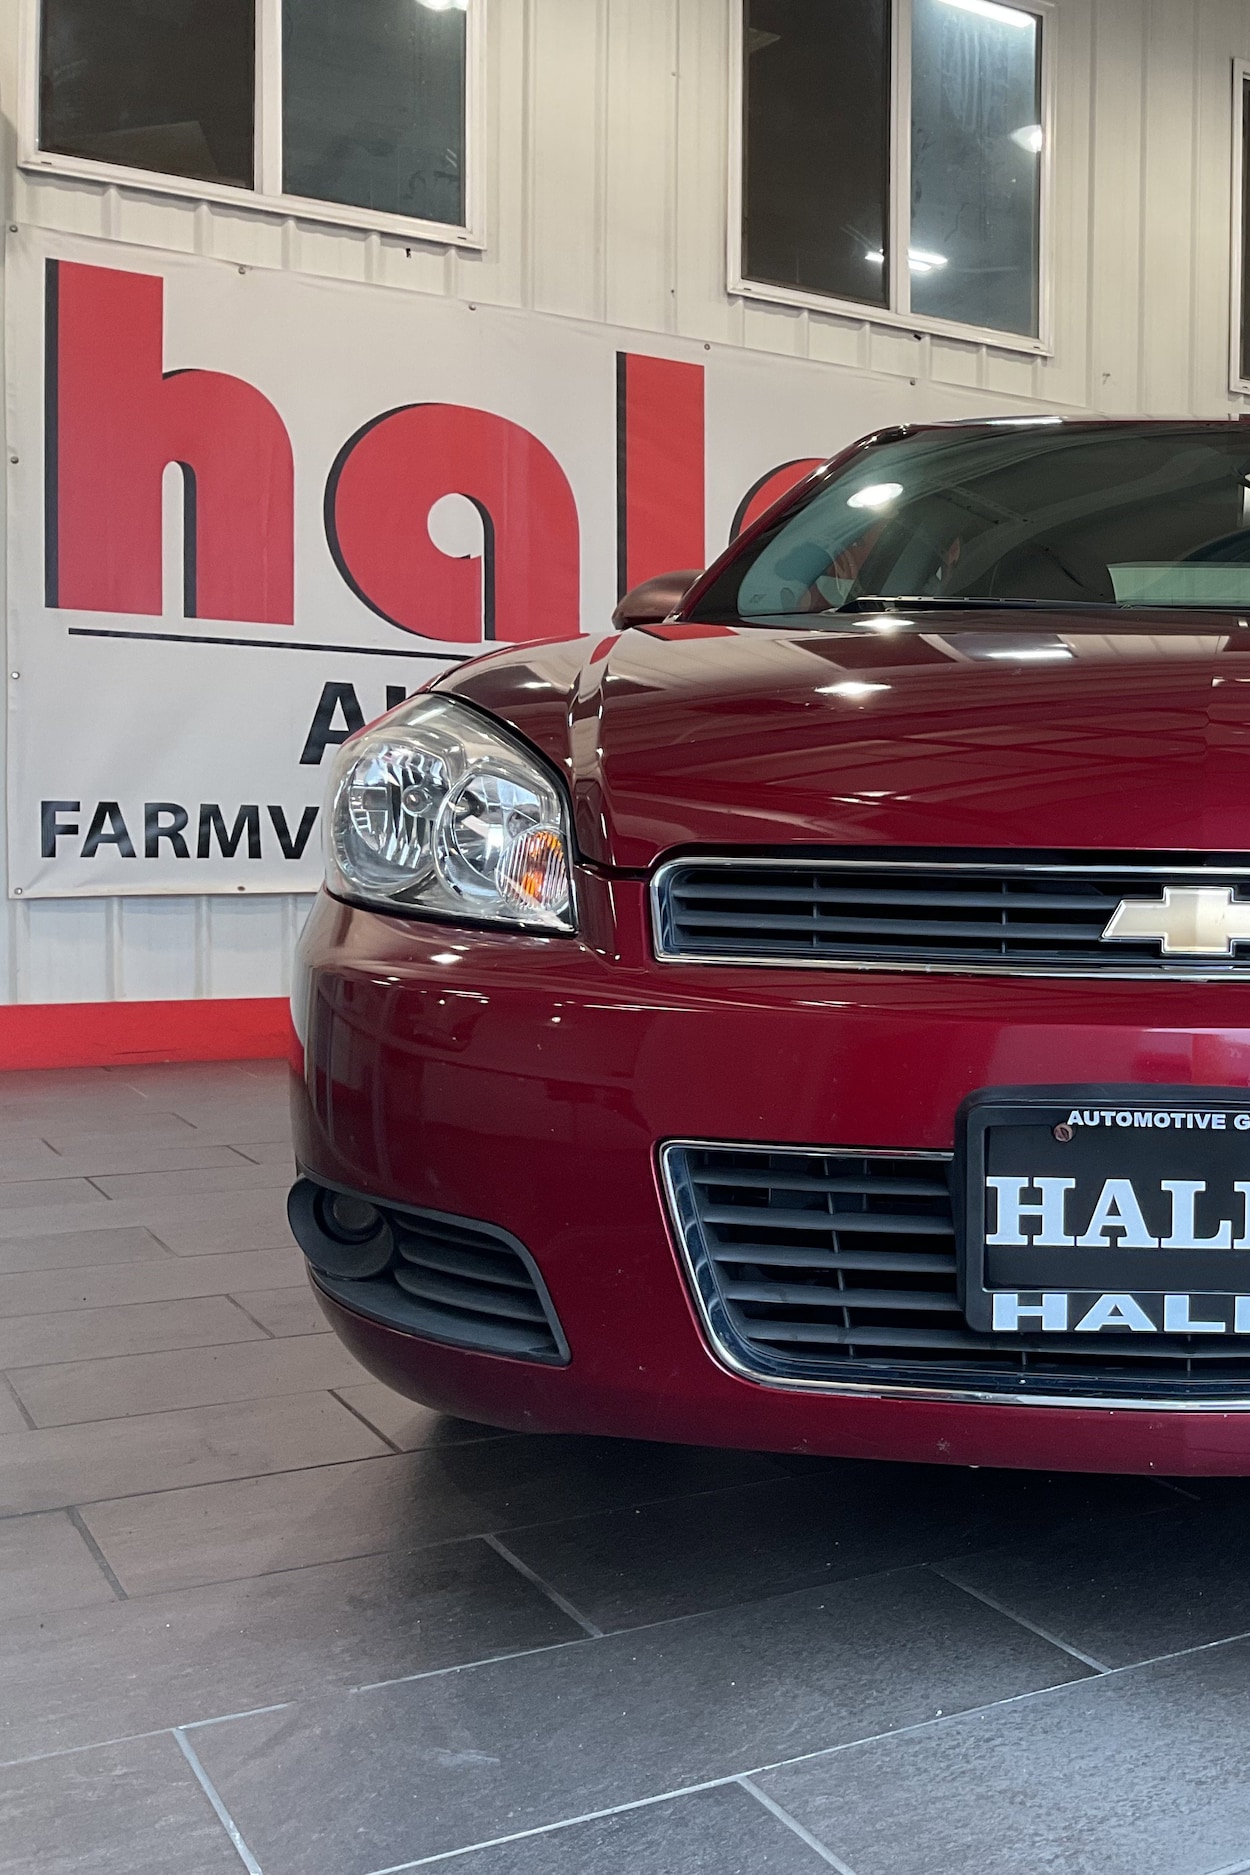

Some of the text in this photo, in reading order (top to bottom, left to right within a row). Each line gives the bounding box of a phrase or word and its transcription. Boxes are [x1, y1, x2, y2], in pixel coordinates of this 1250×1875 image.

[45, 258, 828, 645] hal
[41, 801, 320, 860] FARMV
[1067, 1110, 1226, 1130] AUTOMOTIVE
